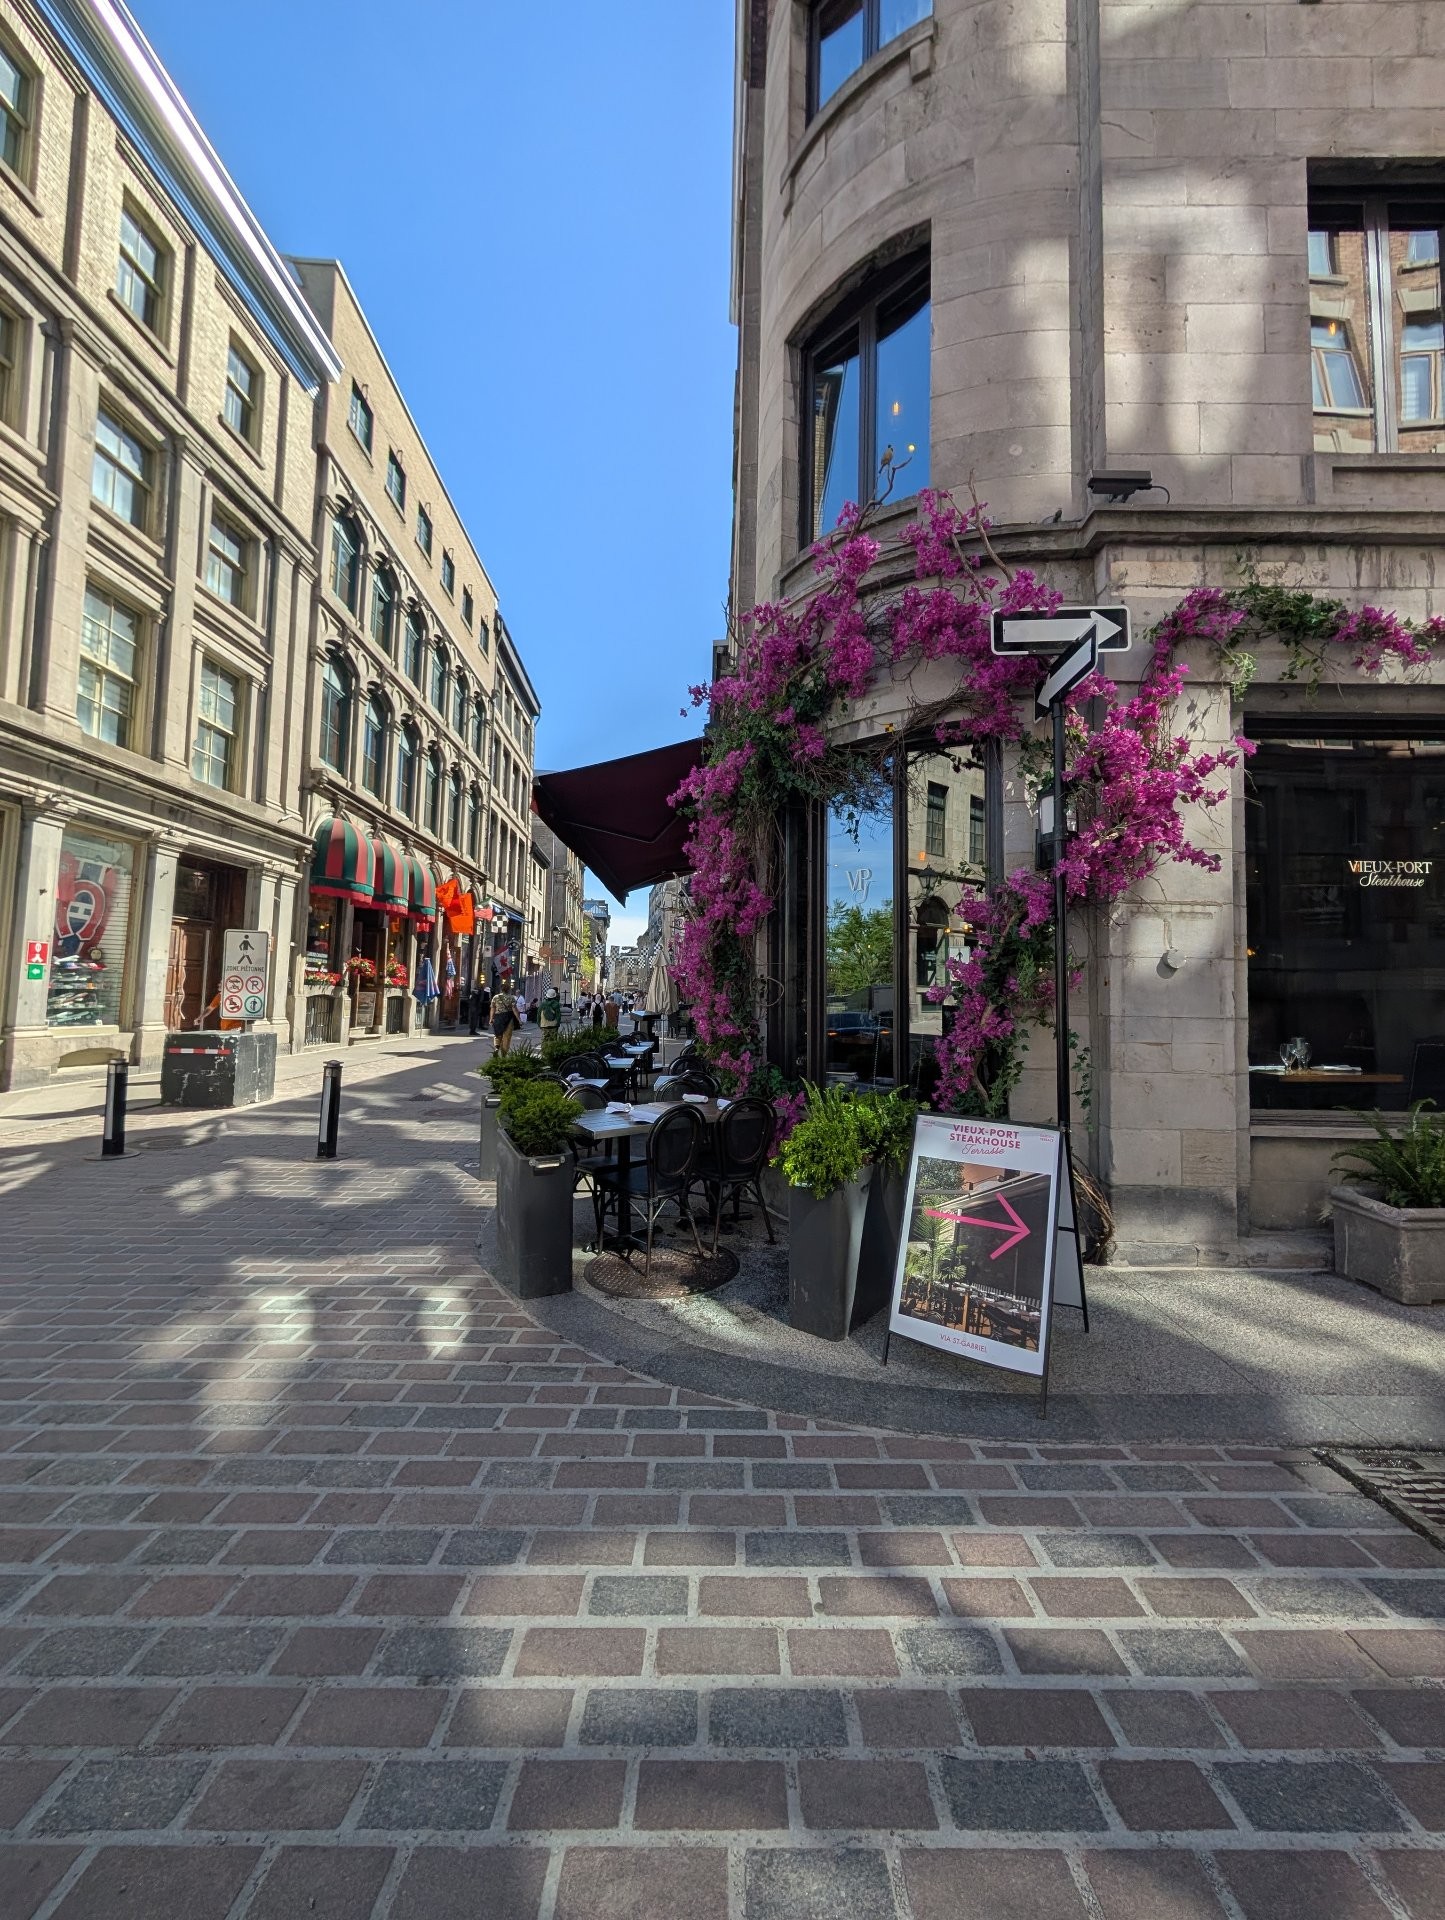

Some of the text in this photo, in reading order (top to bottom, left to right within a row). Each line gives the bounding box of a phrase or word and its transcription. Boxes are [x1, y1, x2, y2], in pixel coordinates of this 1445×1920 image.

[1348, 860, 1432, 873] VIEUX-PORT
[1359, 871, 1425, 887] Steakhouse
[953, 1125, 1020, 1139] VIEUX-PORT
[949, 1133, 1021, 1149] STEAKHOUSE
[961, 1143, 1005, 1155] Terrasse
[940, 1333, 951, 1342] VIA
